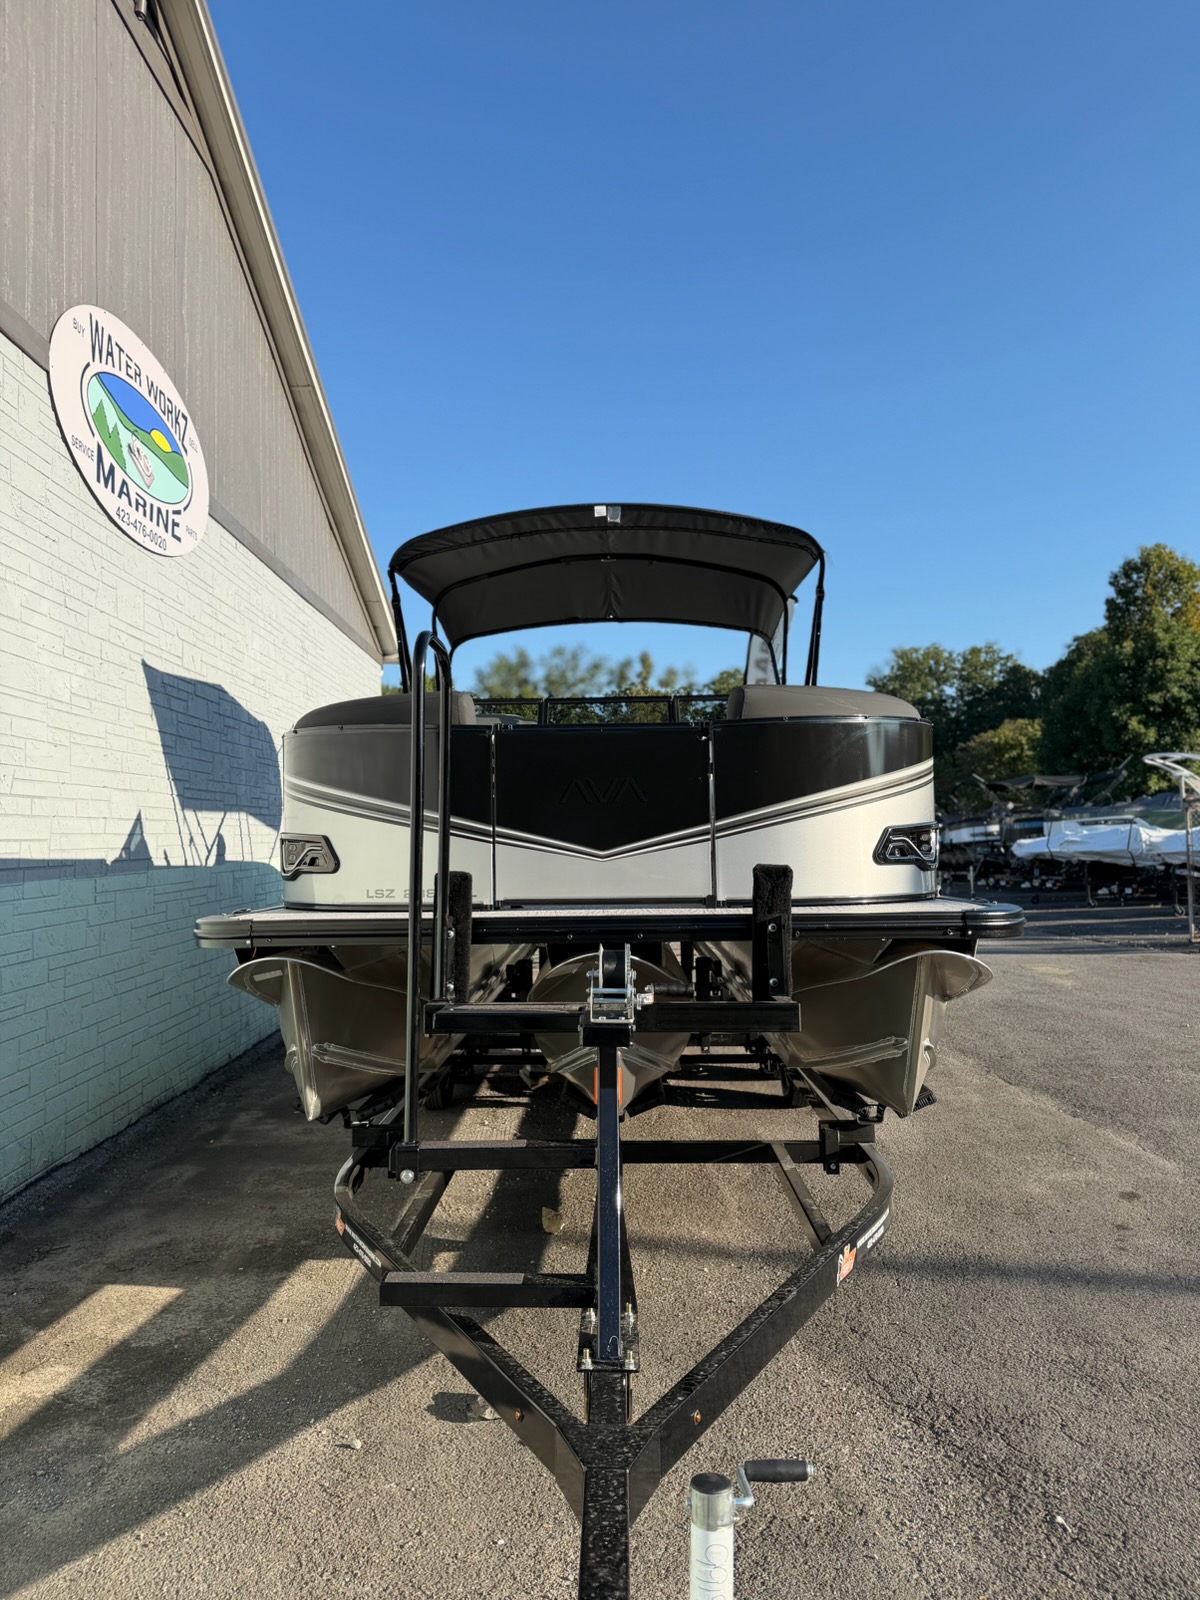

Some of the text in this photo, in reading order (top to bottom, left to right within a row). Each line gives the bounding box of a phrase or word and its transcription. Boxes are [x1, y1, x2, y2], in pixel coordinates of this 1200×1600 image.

[73, 317, 85, 337] BUY
[89, 311, 189, 457] WATER WORKZ
[71, 434, 95, 462] SERVICE
[96, 440, 182, 543] MARINE
[115, 505, 168, 551] 423-476-0020
[366, 889, 396, 899] LSZ
